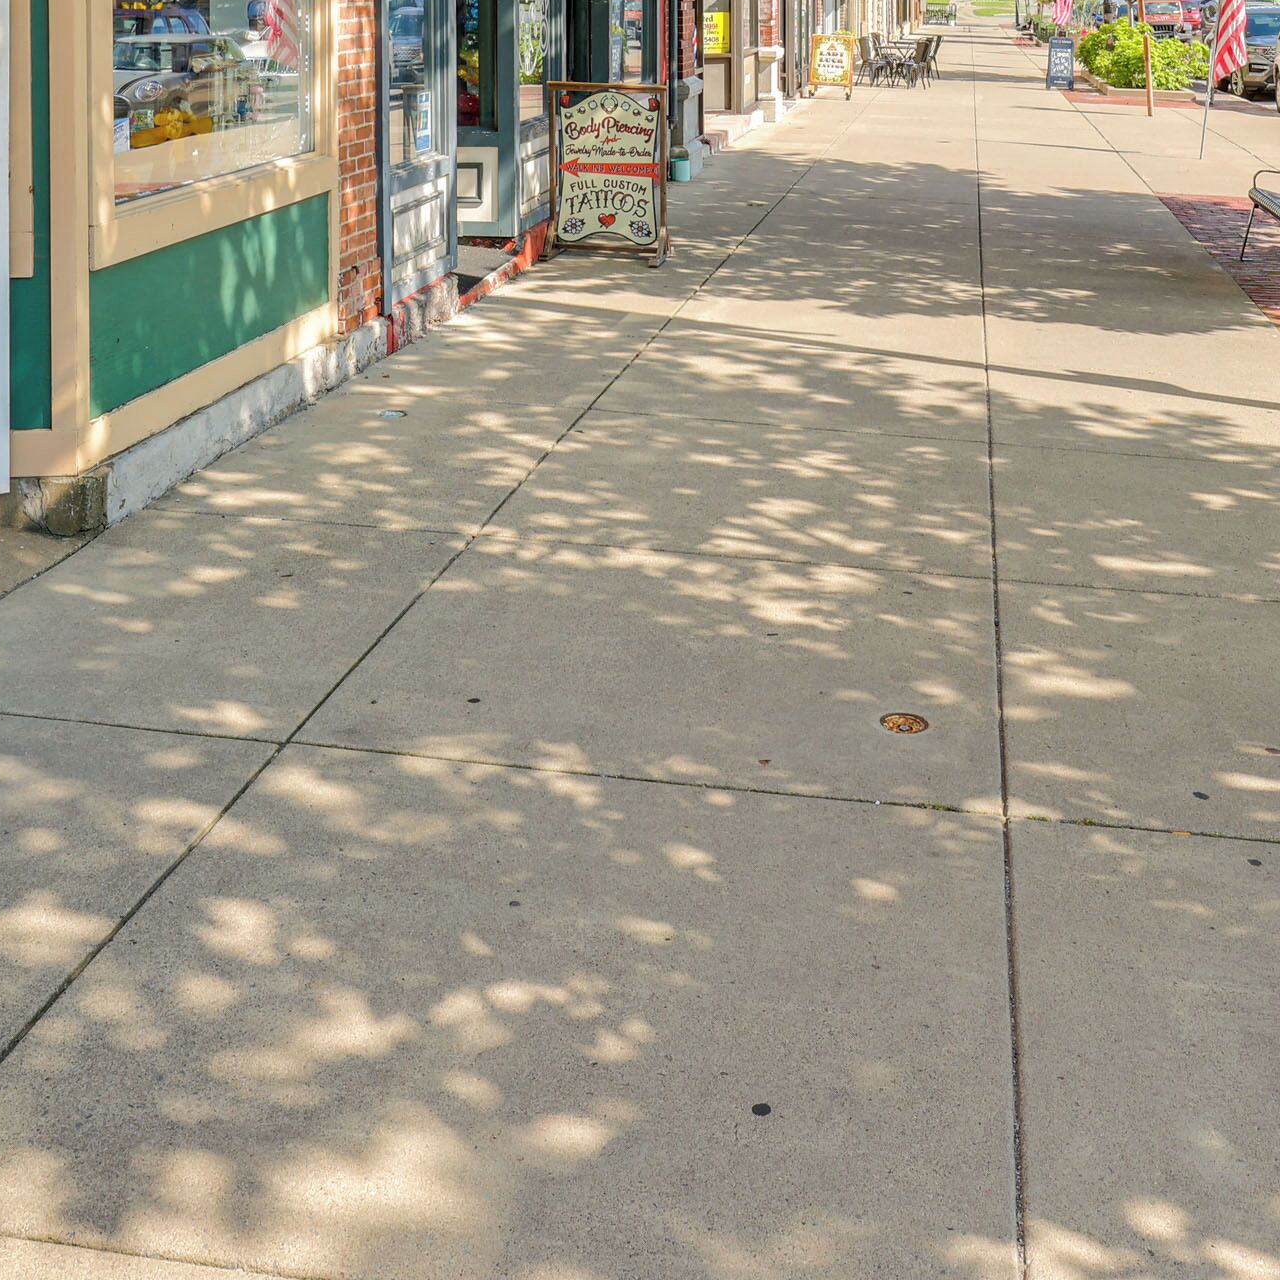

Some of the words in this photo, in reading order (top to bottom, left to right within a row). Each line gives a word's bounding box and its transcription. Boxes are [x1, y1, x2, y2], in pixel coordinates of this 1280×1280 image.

[565, 118, 600, 140] Body
[601, 116, 654, 143] Piercing
[567, 163, 589, 172] WALK
[570, 179, 598, 192] FULL
[603, 178, 647, 195] CUSTOM
[565, 189, 650, 218] TATTOOS
